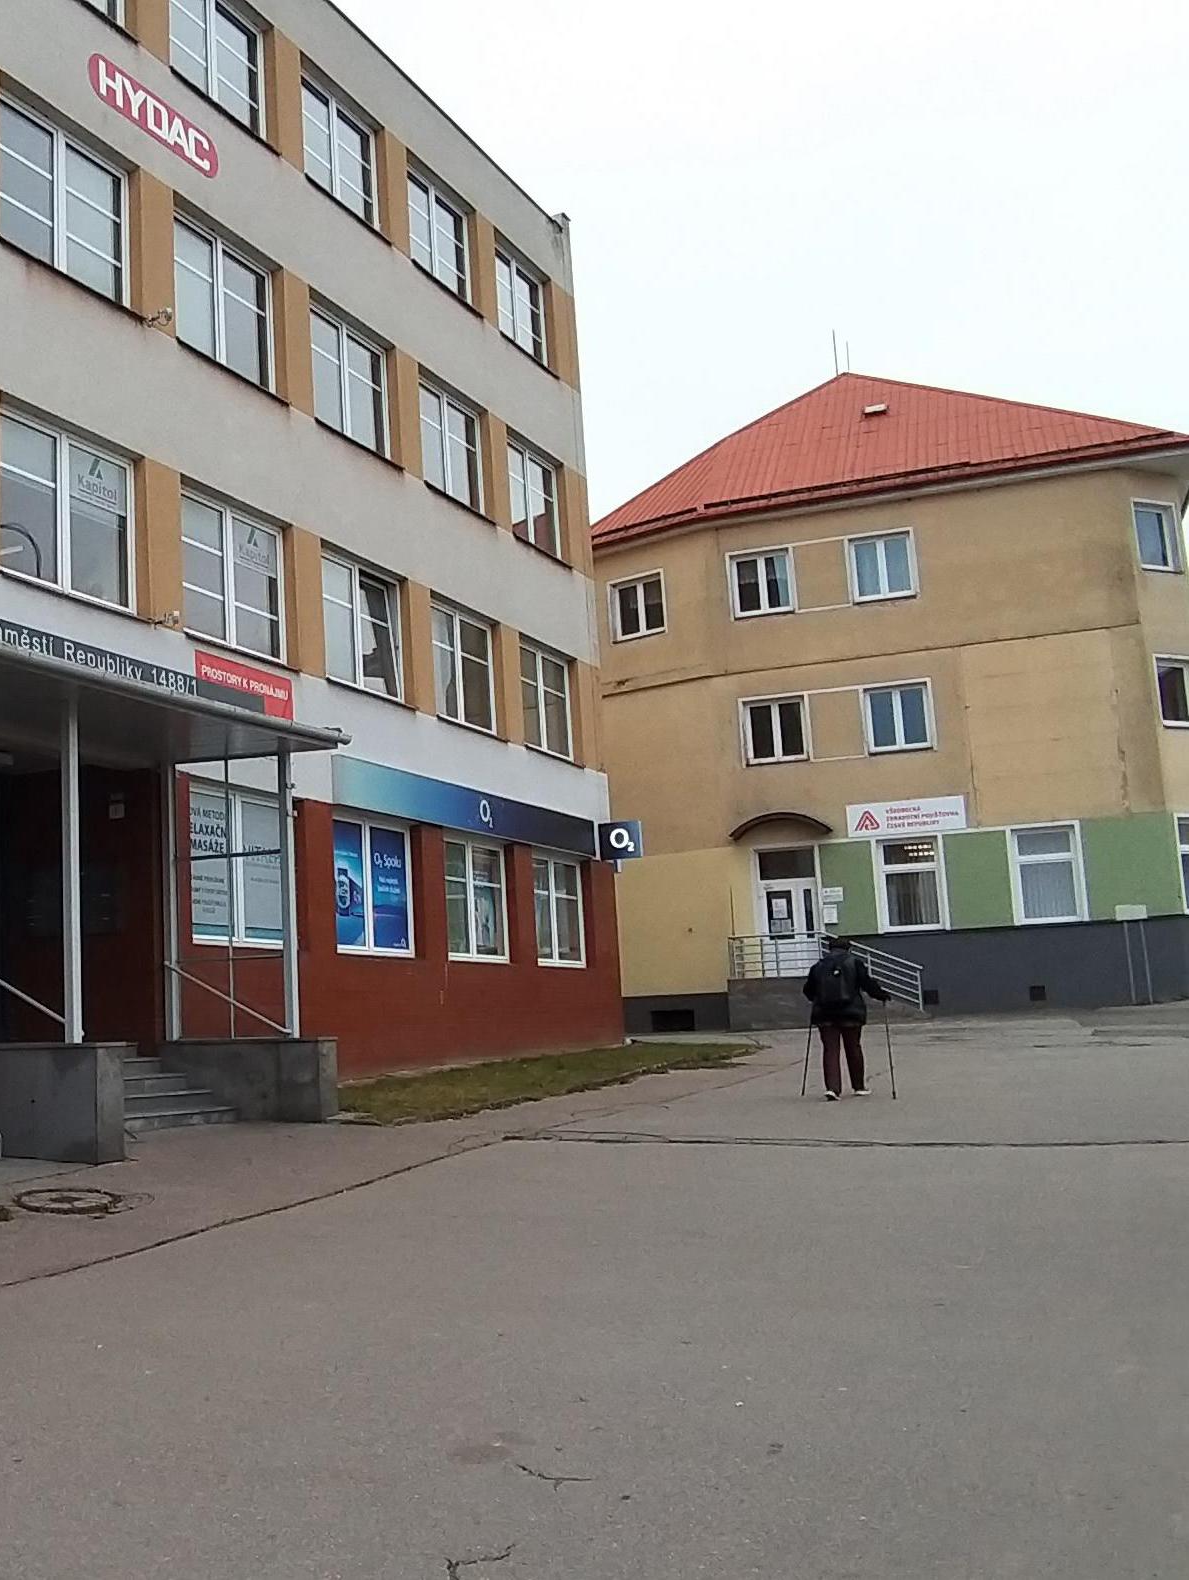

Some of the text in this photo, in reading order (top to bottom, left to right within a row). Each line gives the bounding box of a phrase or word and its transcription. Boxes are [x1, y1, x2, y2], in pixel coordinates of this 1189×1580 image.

[98, 58, 211, 172] HYDAC
[77, 472, 118, 502] Kapitol
[151, 668, 198, 697] 1488/1
[201, 664, 242, 687] PROSTORY
[249, 679, 289, 701] PRONÁJMU
[190, 821, 227, 839] ELAXAČN
[609, 827, 635, 853] O2
